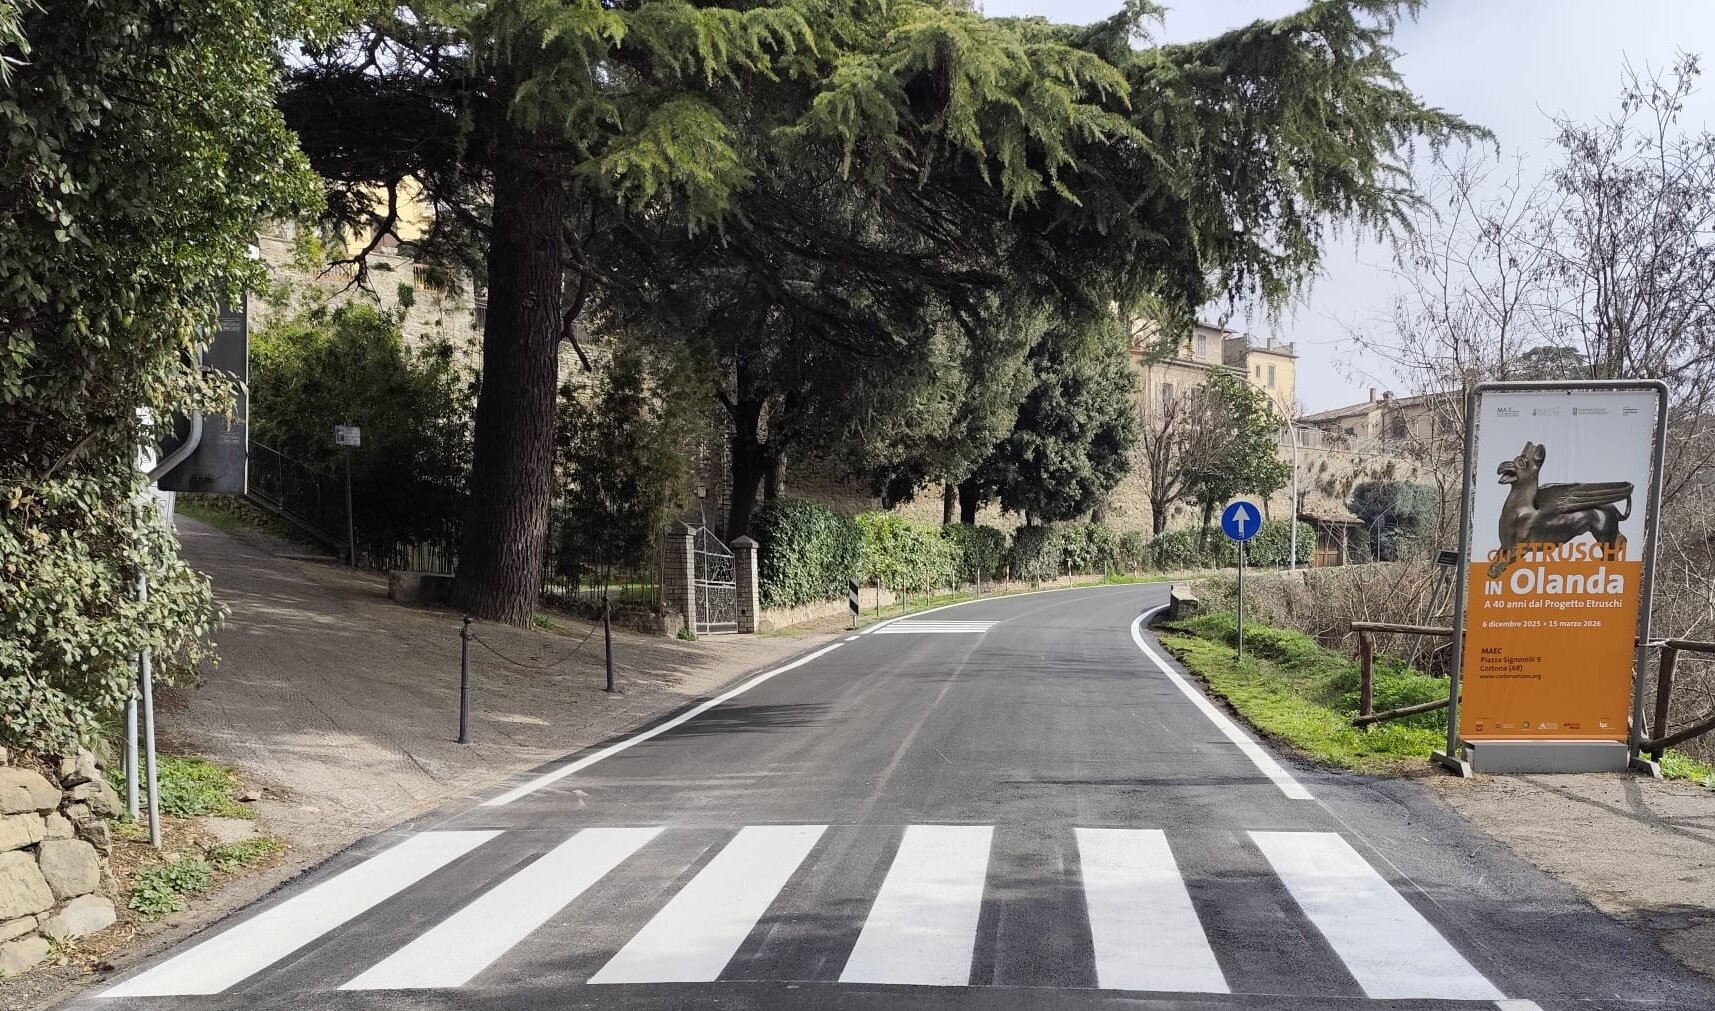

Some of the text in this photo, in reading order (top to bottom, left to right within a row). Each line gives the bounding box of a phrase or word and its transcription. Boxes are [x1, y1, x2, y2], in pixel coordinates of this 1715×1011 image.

[1516, 542, 1627, 562] ETRUSCHI
[1484, 567, 1625, 595] IN Olanda
[1484, 599, 1622, 610] A 40 anni dal Progetto Etruschi
[1489, 620, 1521, 628] dicembre
[1503, 656, 1535, 664] Signorelli
